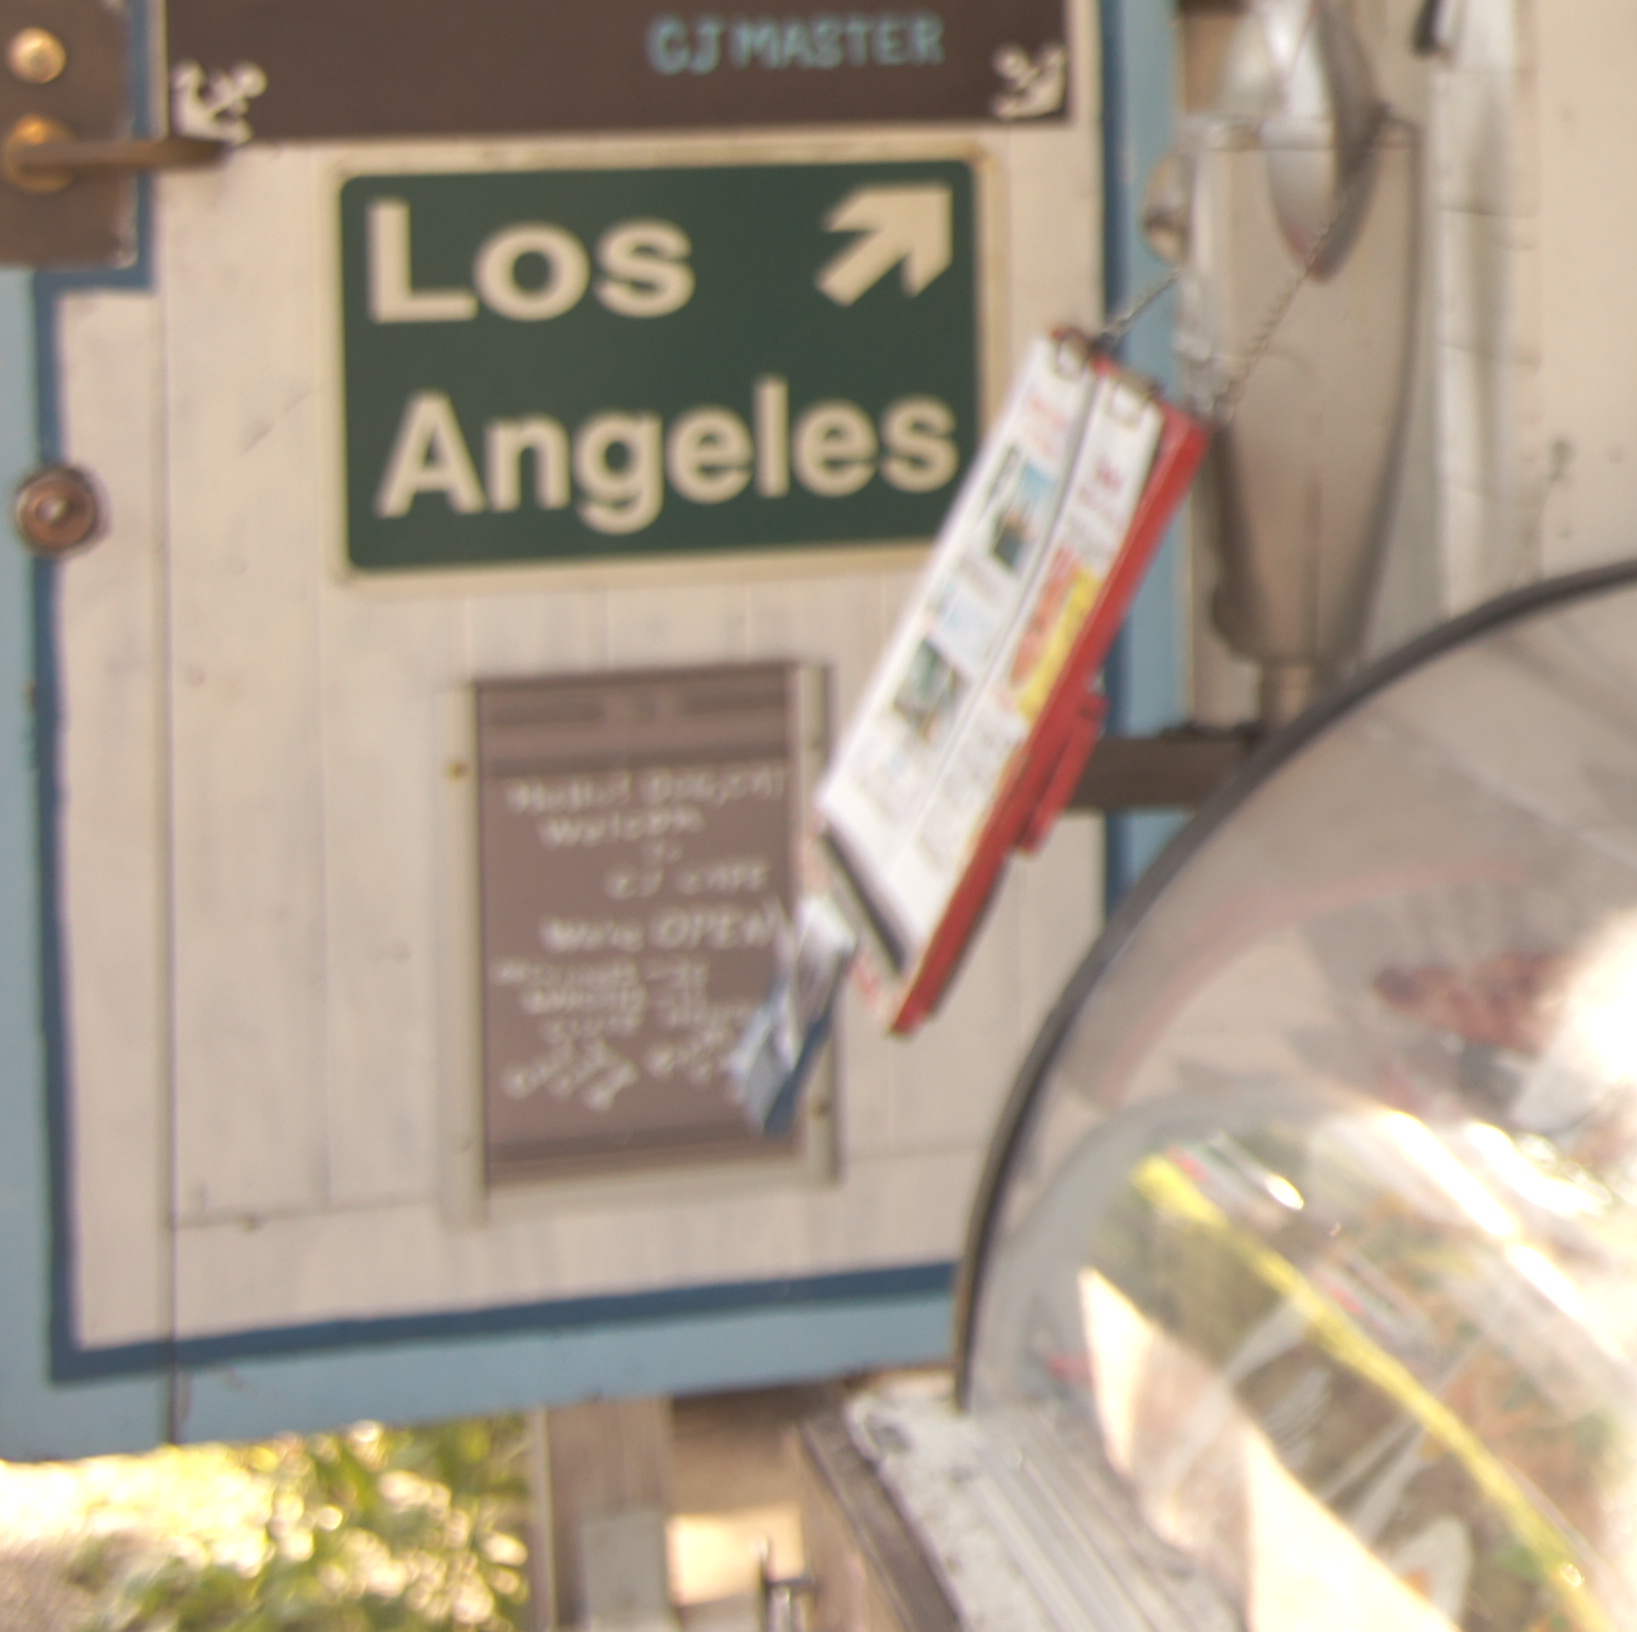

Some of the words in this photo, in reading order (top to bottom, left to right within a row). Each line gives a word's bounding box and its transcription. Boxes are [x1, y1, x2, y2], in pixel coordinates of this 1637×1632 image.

[648, 16, 726, 75] CJ
[730, 13, 945, 71] MASTER
[366, 195, 697, 325] Los
[374, 372, 961, 537] Angeles
